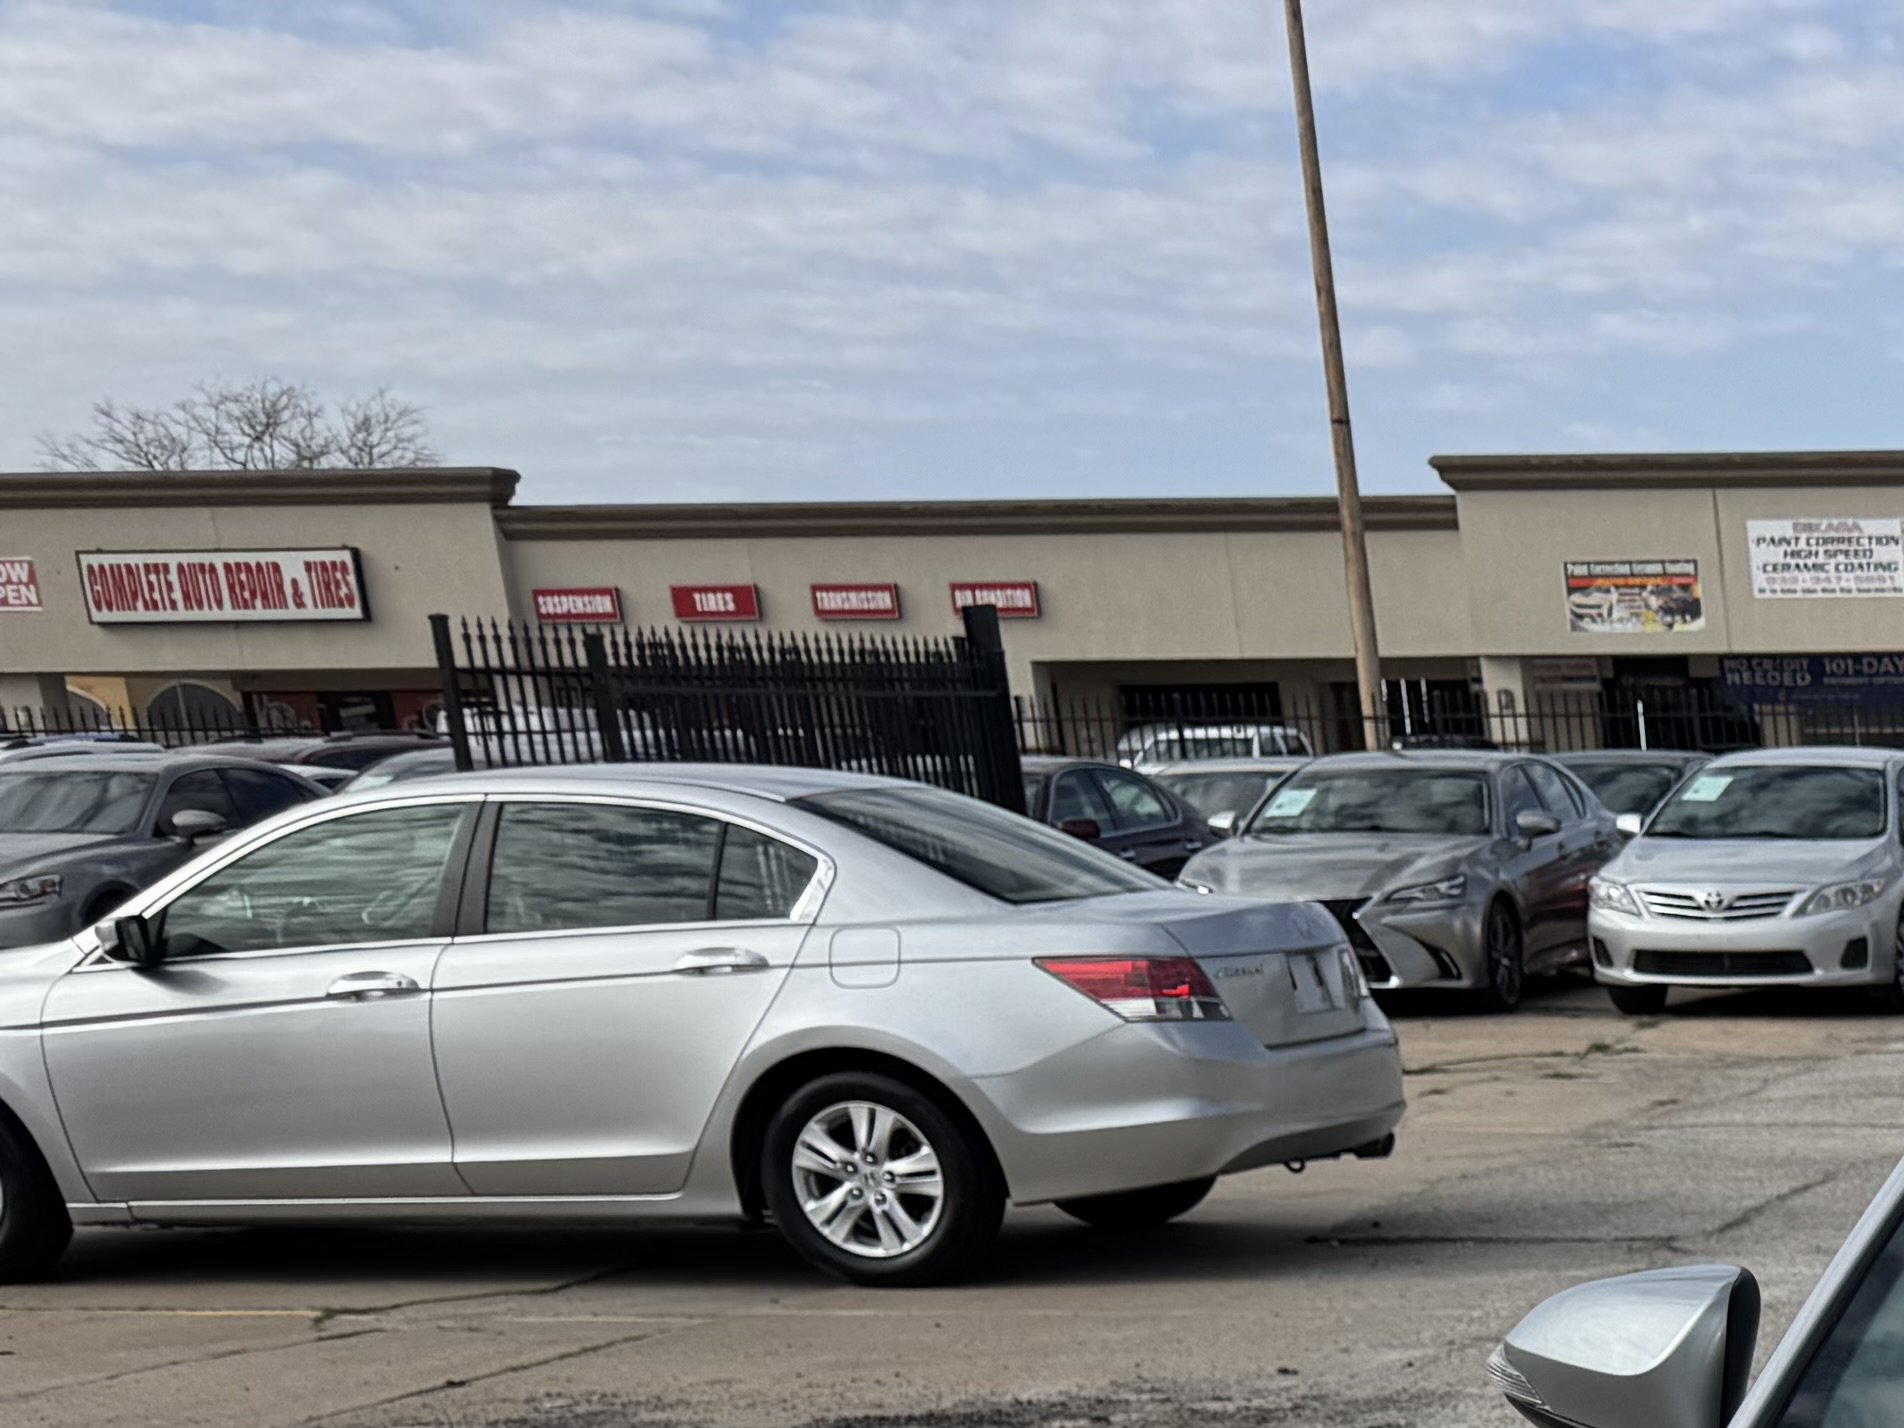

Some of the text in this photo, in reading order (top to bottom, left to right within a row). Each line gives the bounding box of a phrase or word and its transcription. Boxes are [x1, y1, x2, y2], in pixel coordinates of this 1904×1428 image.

[1756, 535, 1900, 547] PAINT CORRECTION
[1783, 549, 1874, 560] HIGH SPEED
[1762, 562, 1899, 574] CERAMIC COATING
[86, 560, 356, 613] COMPLETE AUTO REPAIR & TIRES
[537, 593, 614, 614] SUSPENSION
[692, 592, 736, 612] TIRES
[1726, 671, 1812, 687] NEEDED
